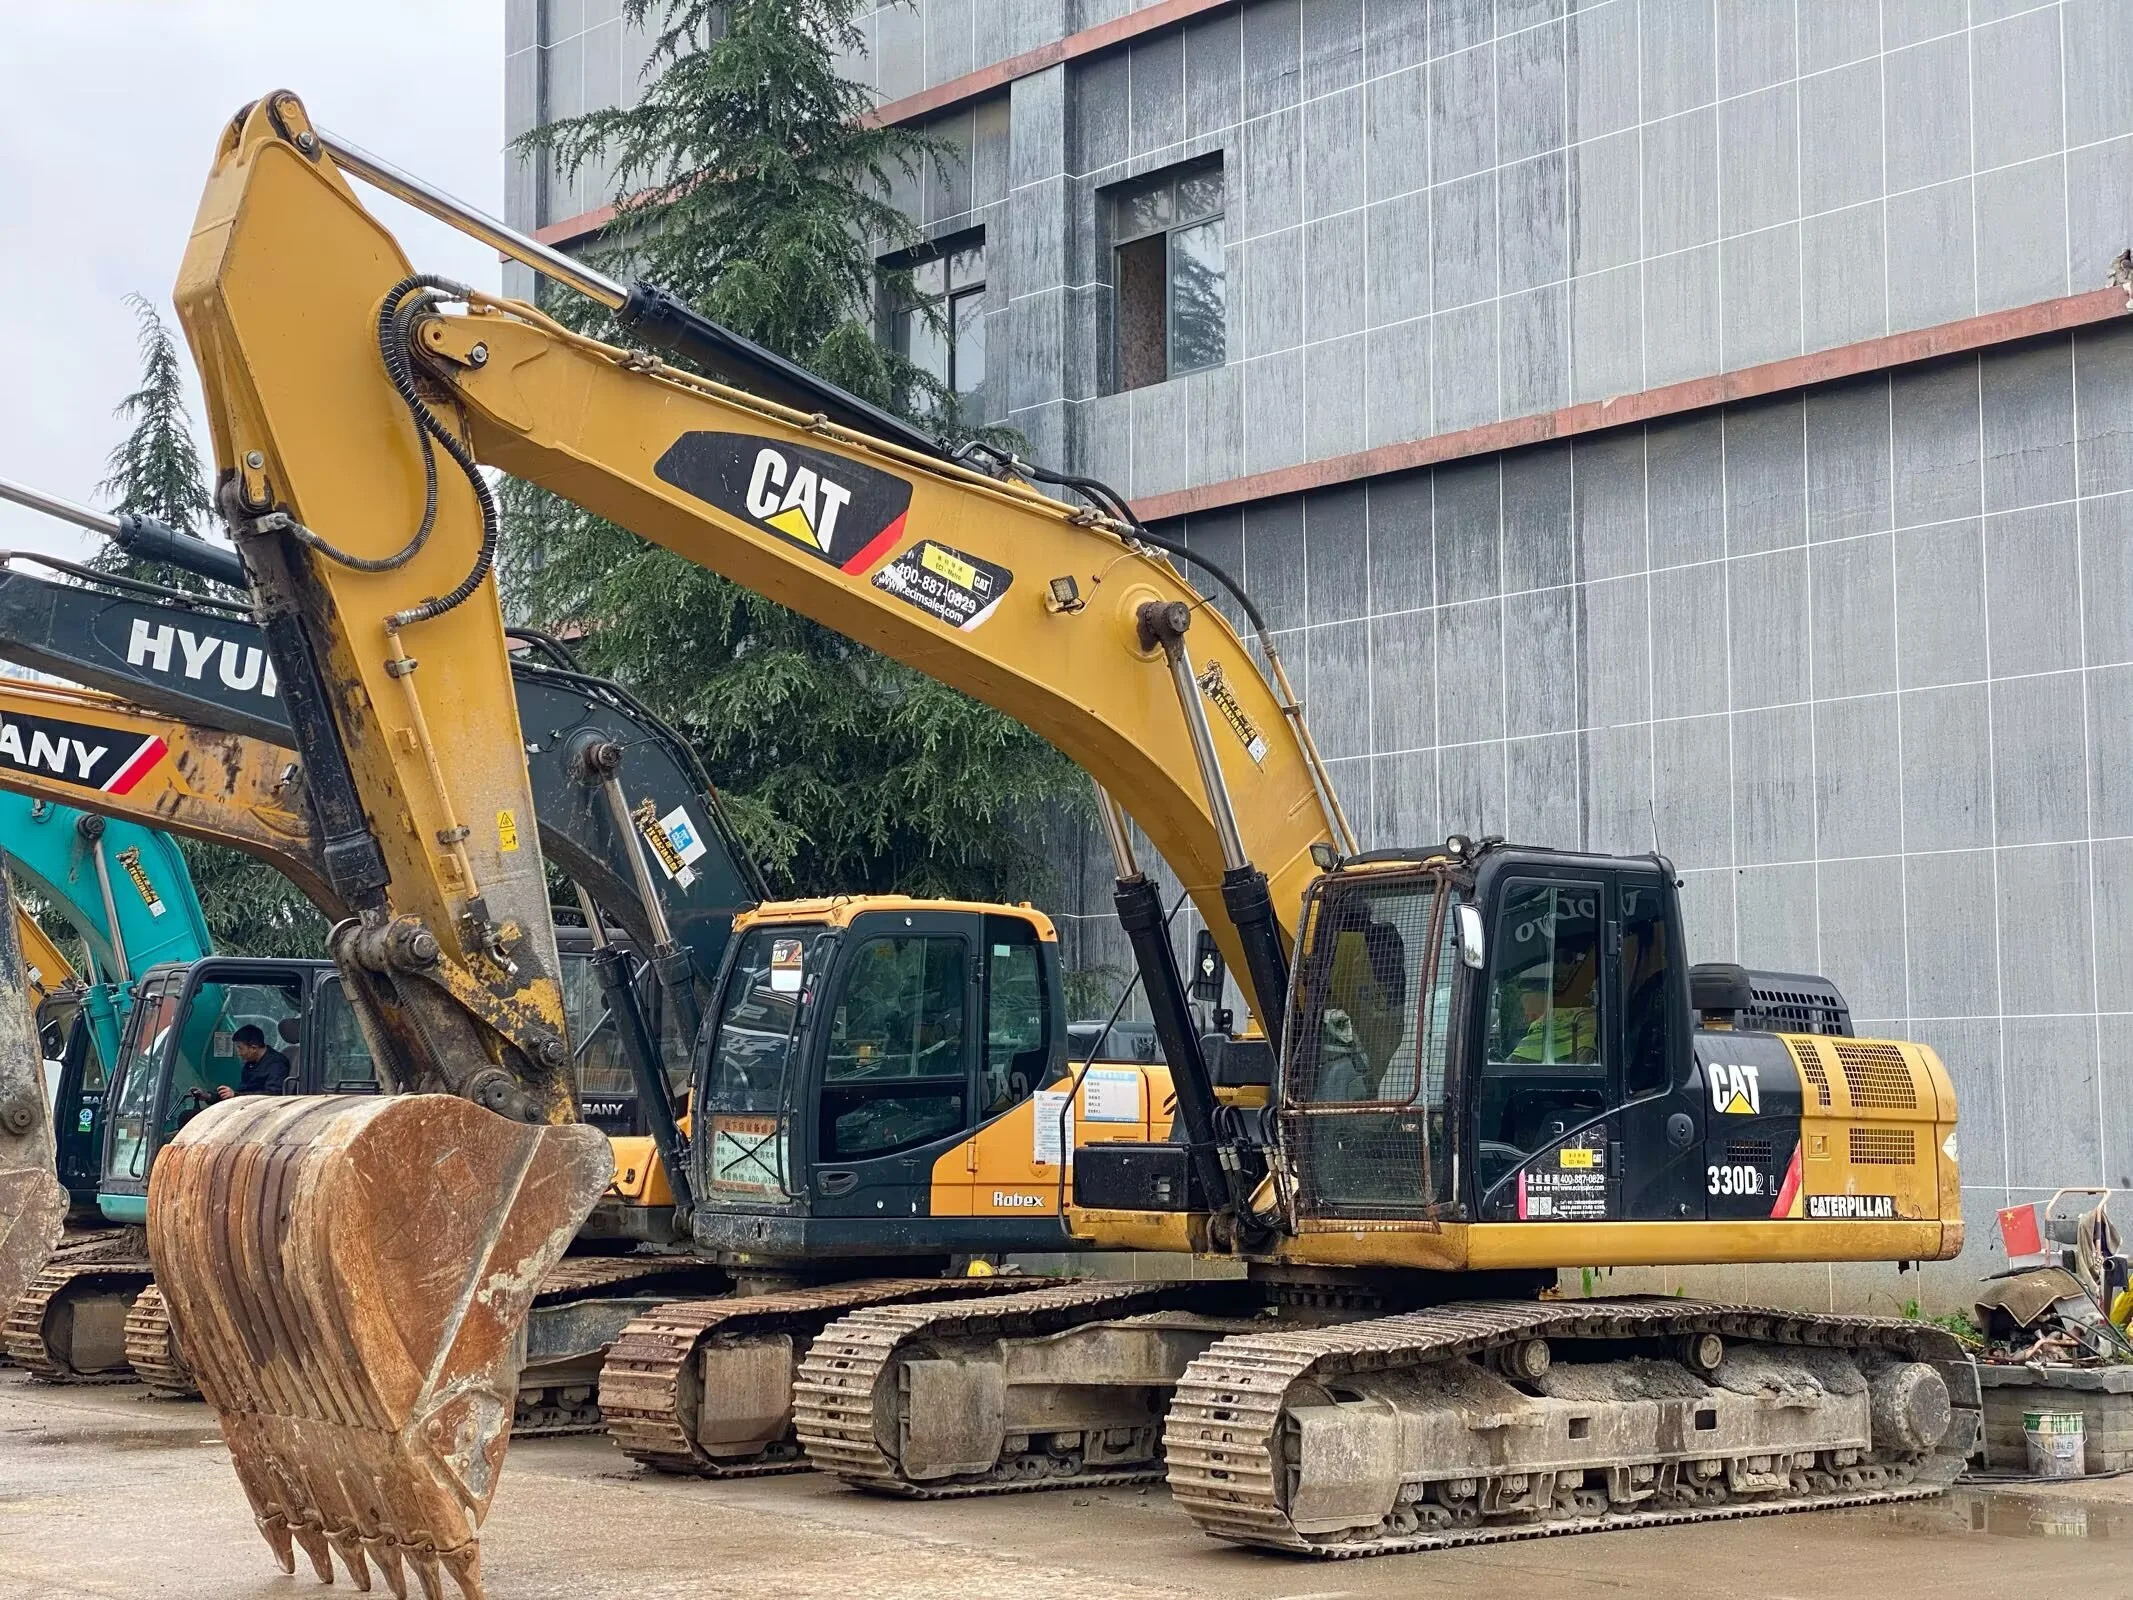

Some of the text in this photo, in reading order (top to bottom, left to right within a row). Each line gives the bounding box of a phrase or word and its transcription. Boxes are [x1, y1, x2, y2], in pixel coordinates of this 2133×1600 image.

[746, 448, 851, 554] CAT
[896, 562, 977, 614] 400-887-0829
[974, 575, 990, 592] CAT
[0, 713, 108, 780] ANY
[1708, 1063, 1760, 1115] CAT
[582, 1103, 623, 1116] SANY
[1561, 1174, 1605, 1184] 400-887-0829
[1769, 1174, 1778, 1196] L
[993, 1191, 1045, 1207] Robex
[1810, 1196, 1892, 1217] CATERPILLAR
